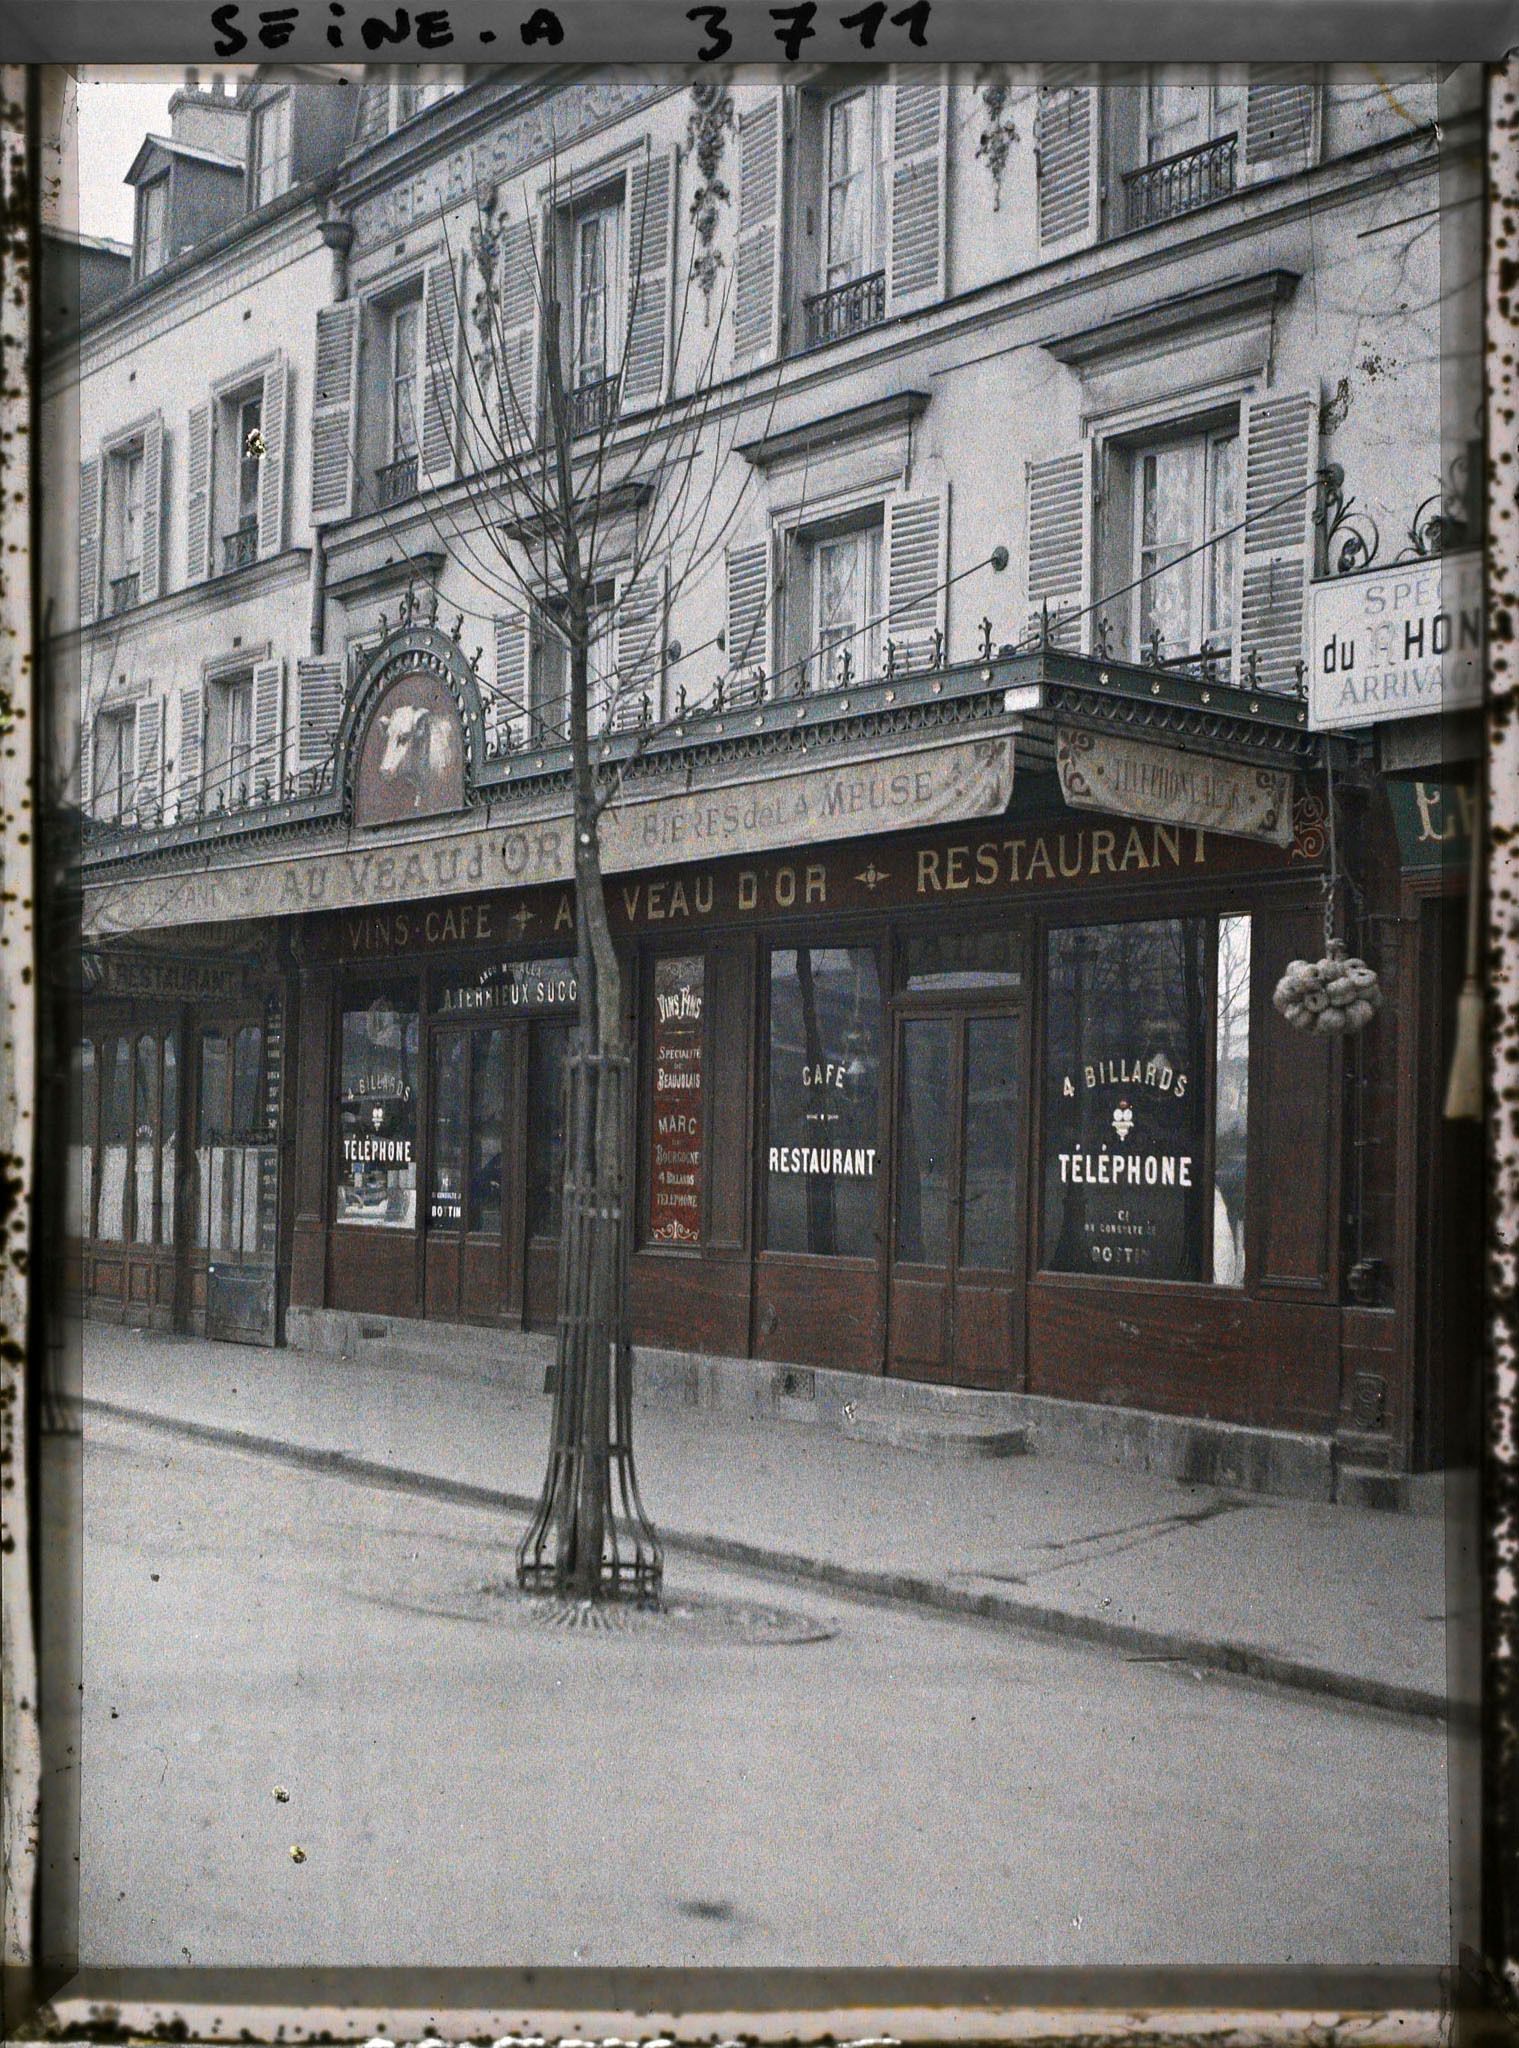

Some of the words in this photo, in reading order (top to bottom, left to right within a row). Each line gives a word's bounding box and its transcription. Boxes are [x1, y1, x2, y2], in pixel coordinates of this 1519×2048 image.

[1323, 632, 1355, 674] du
[820, 773, 933, 817] MEUSE
[279, 864, 327, 903] AU
[345, 847, 462, 897] VEAU
[623, 877, 715, 921] VEAU
[738, 864, 827, 911] D'OR
[917, 822, 1208, 893] RESTAURANT
[359, 1073, 411, 1106] BILLARDS
[802, 1060, 847, 1088] CAFÉ
[1062, 1076, 1075, 1097] 4
[1084, 1059, 1188, 1098] BILLARDS
[658, 1115, 697, 1135] MARC
[344, 1133, 412, 1162] TÉLÉPHONE
[768, 1146, 877, 1176] RESTAURANT
[1058, 1143, 1193, 1187] TÉLÉPHONE
